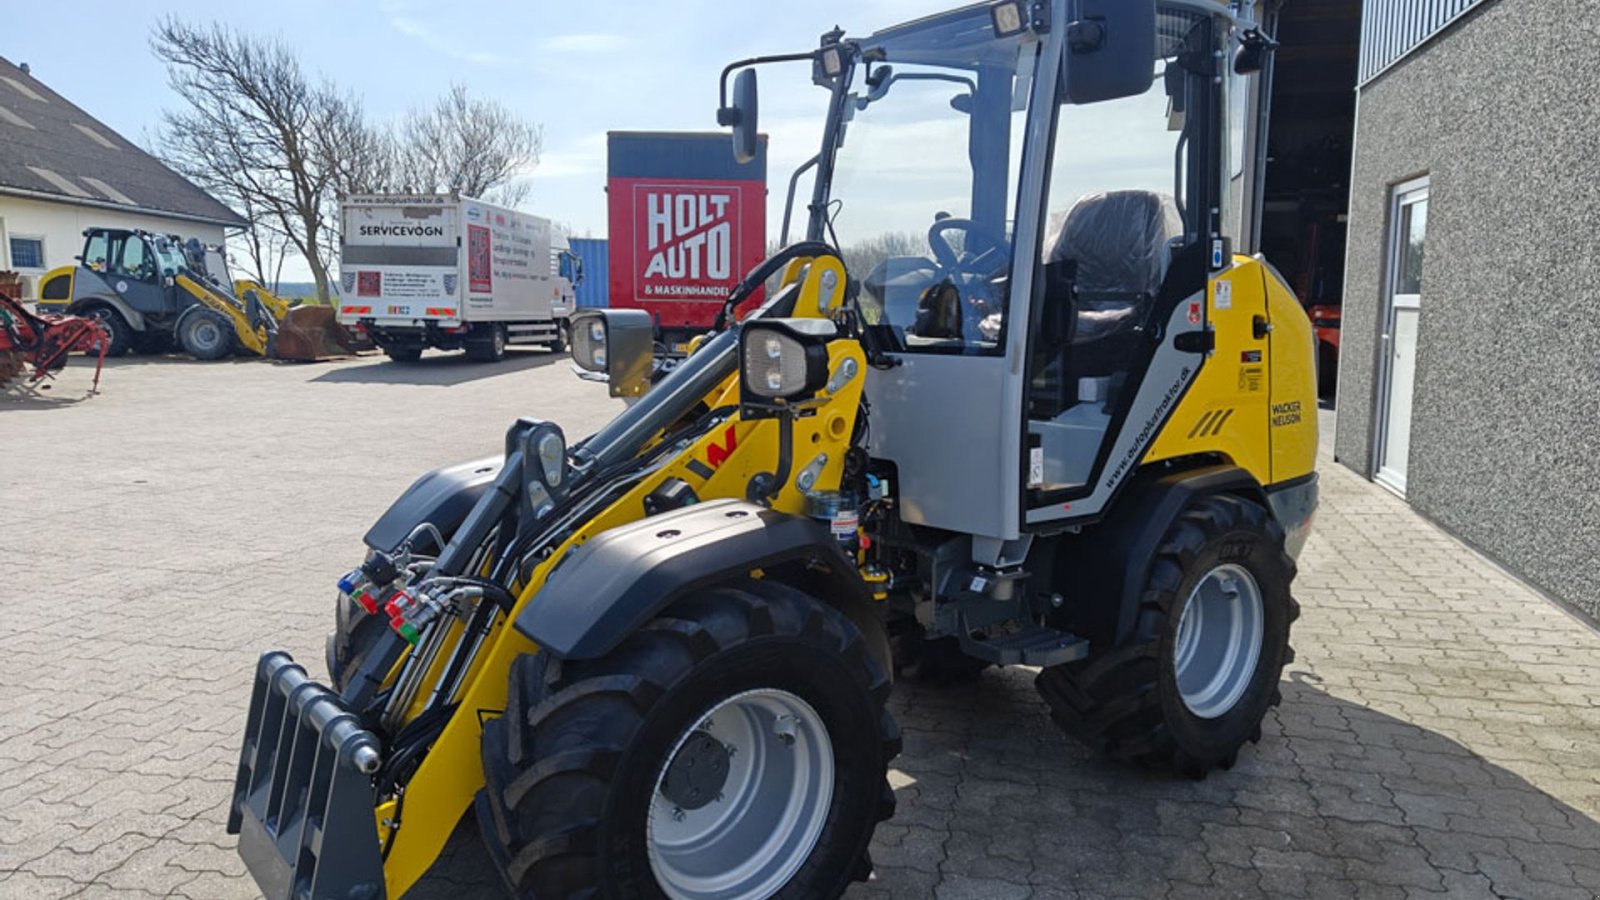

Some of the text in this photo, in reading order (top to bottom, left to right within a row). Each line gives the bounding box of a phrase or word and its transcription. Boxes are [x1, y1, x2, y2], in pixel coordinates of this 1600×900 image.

[647, 193, 731, 251] HOLT
[359, 226, 443, 237] SERVICEVOGN
[644, 221, 731, 279] AUTO
[644, 284, 730, 296] & MASKINHANDEL
[1272, 401, 1301, 415] WACKER
[1272, 413, 1301, 426] NEUSON
[1106, 366, 1191, 488] www.autoplustraktor.dk
